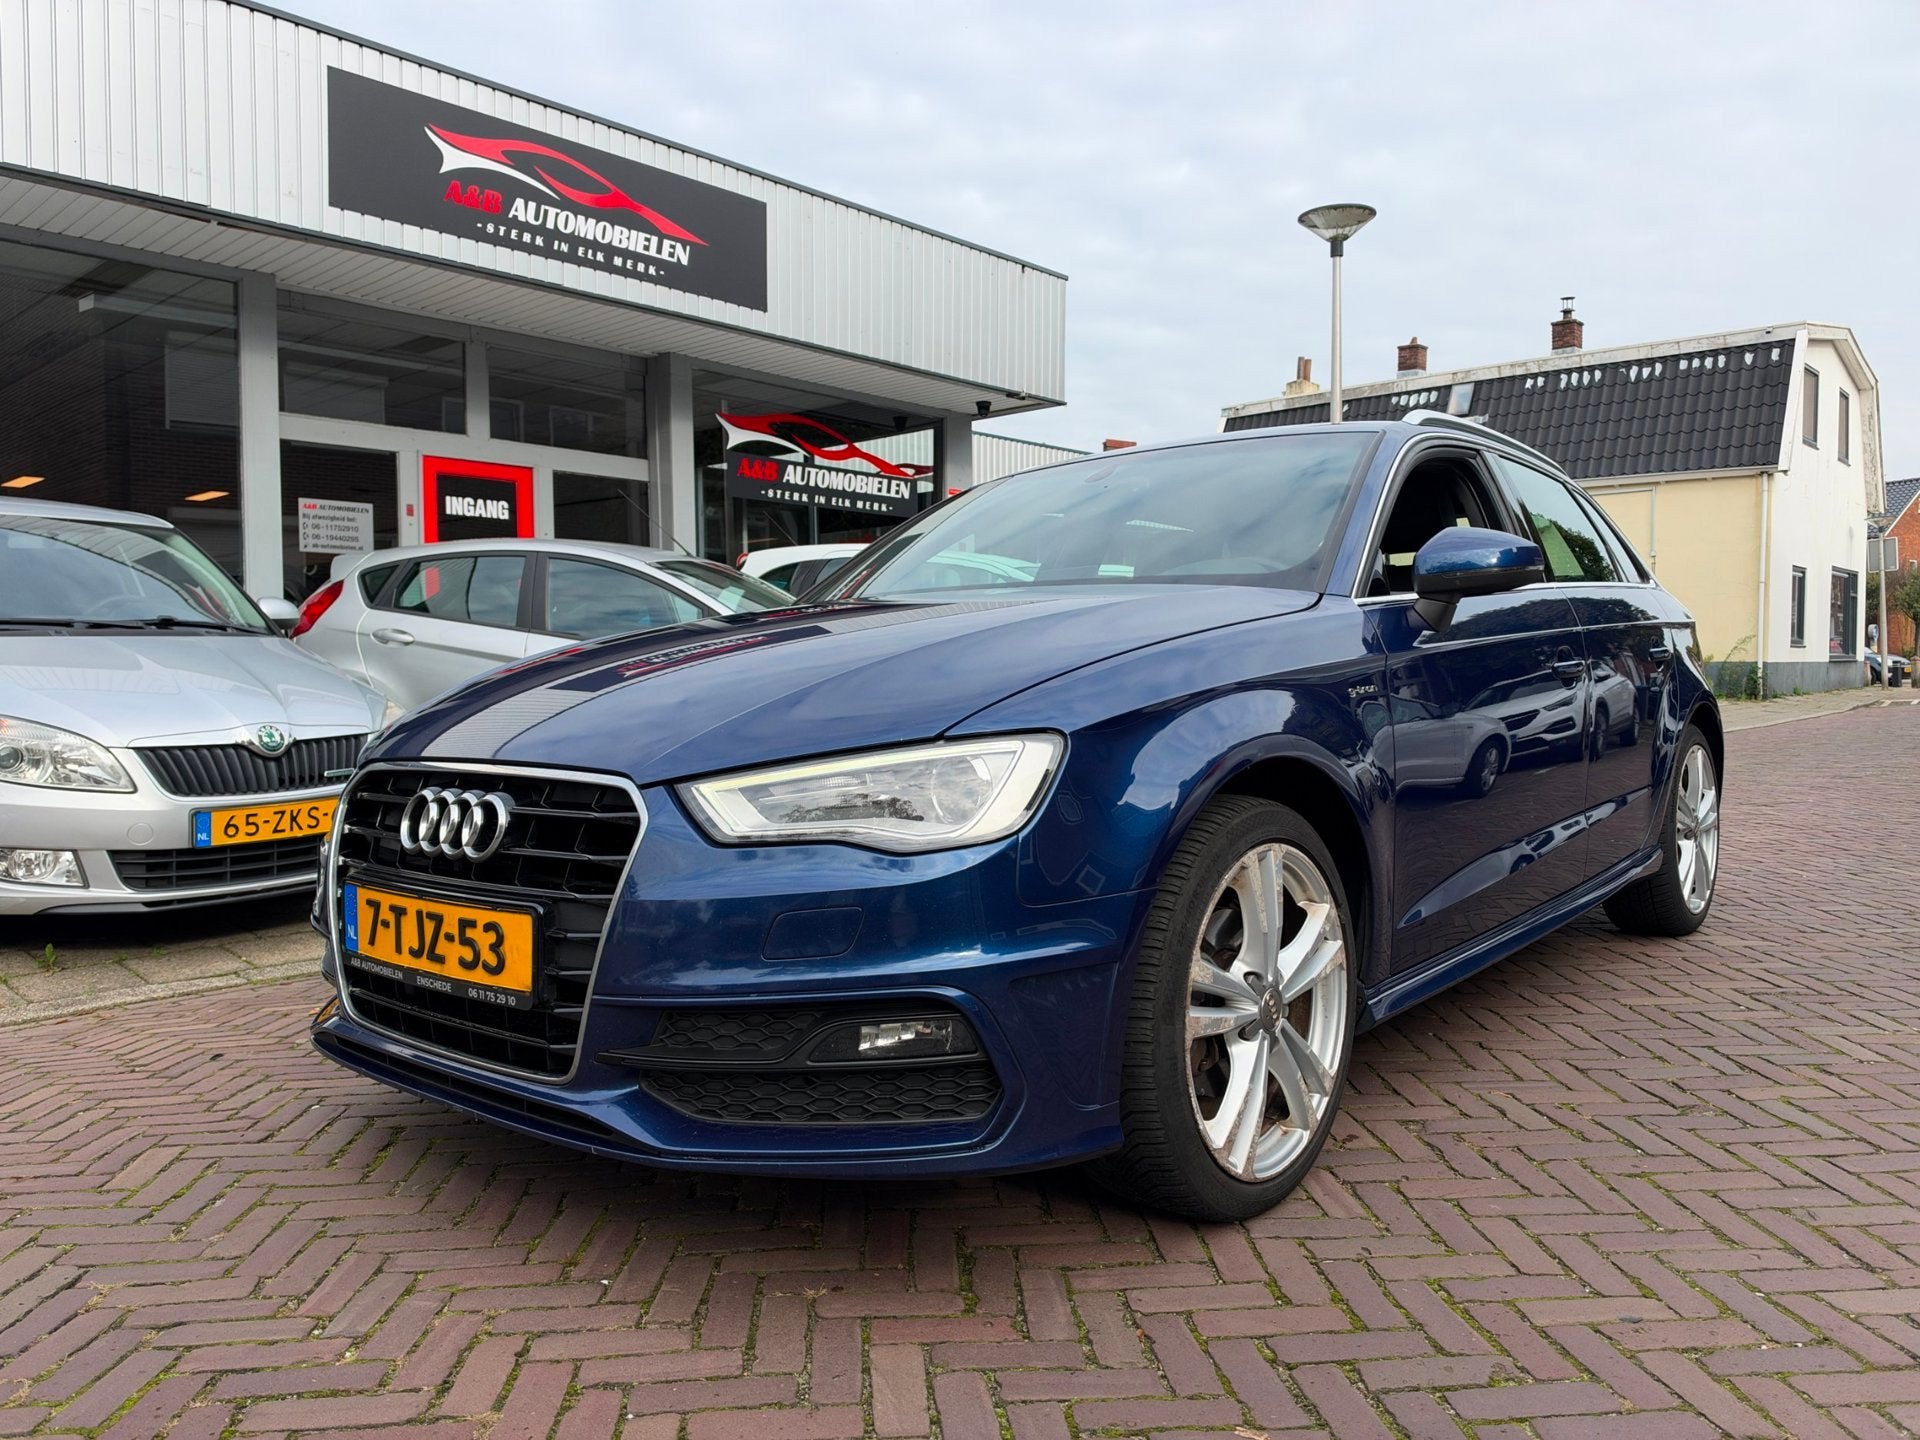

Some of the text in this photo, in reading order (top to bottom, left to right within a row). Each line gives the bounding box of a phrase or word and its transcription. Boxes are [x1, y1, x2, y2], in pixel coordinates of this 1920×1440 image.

[444, 180, 691, 266] A&B AUTOMOBIELEN
[553, 239, 569, 253] IN
[577, 246, 605, 263] ELK
[737, 457, 911, 500] A&B AUTOMOBIELEN
[319, 504, 369, 514] AUTOMOBIELEN
[445, 495, 509, 521] INGANG
[814, 494, 826, 505] IN
[831, 496, 851, 508] ELK
[312, 514, 345, 522] afwezigheid
[223, 806, 336, 838] 65-ZKS-
[197, 831, 209, 841] NL
[347, 925, 357, 940] NL
[365, 898, 506, 976] 7-TJZ-53
[351, 957, 516, 1006] A&B AUTOMOBIELEN ENSCHEDE 06 11 75 29 10
